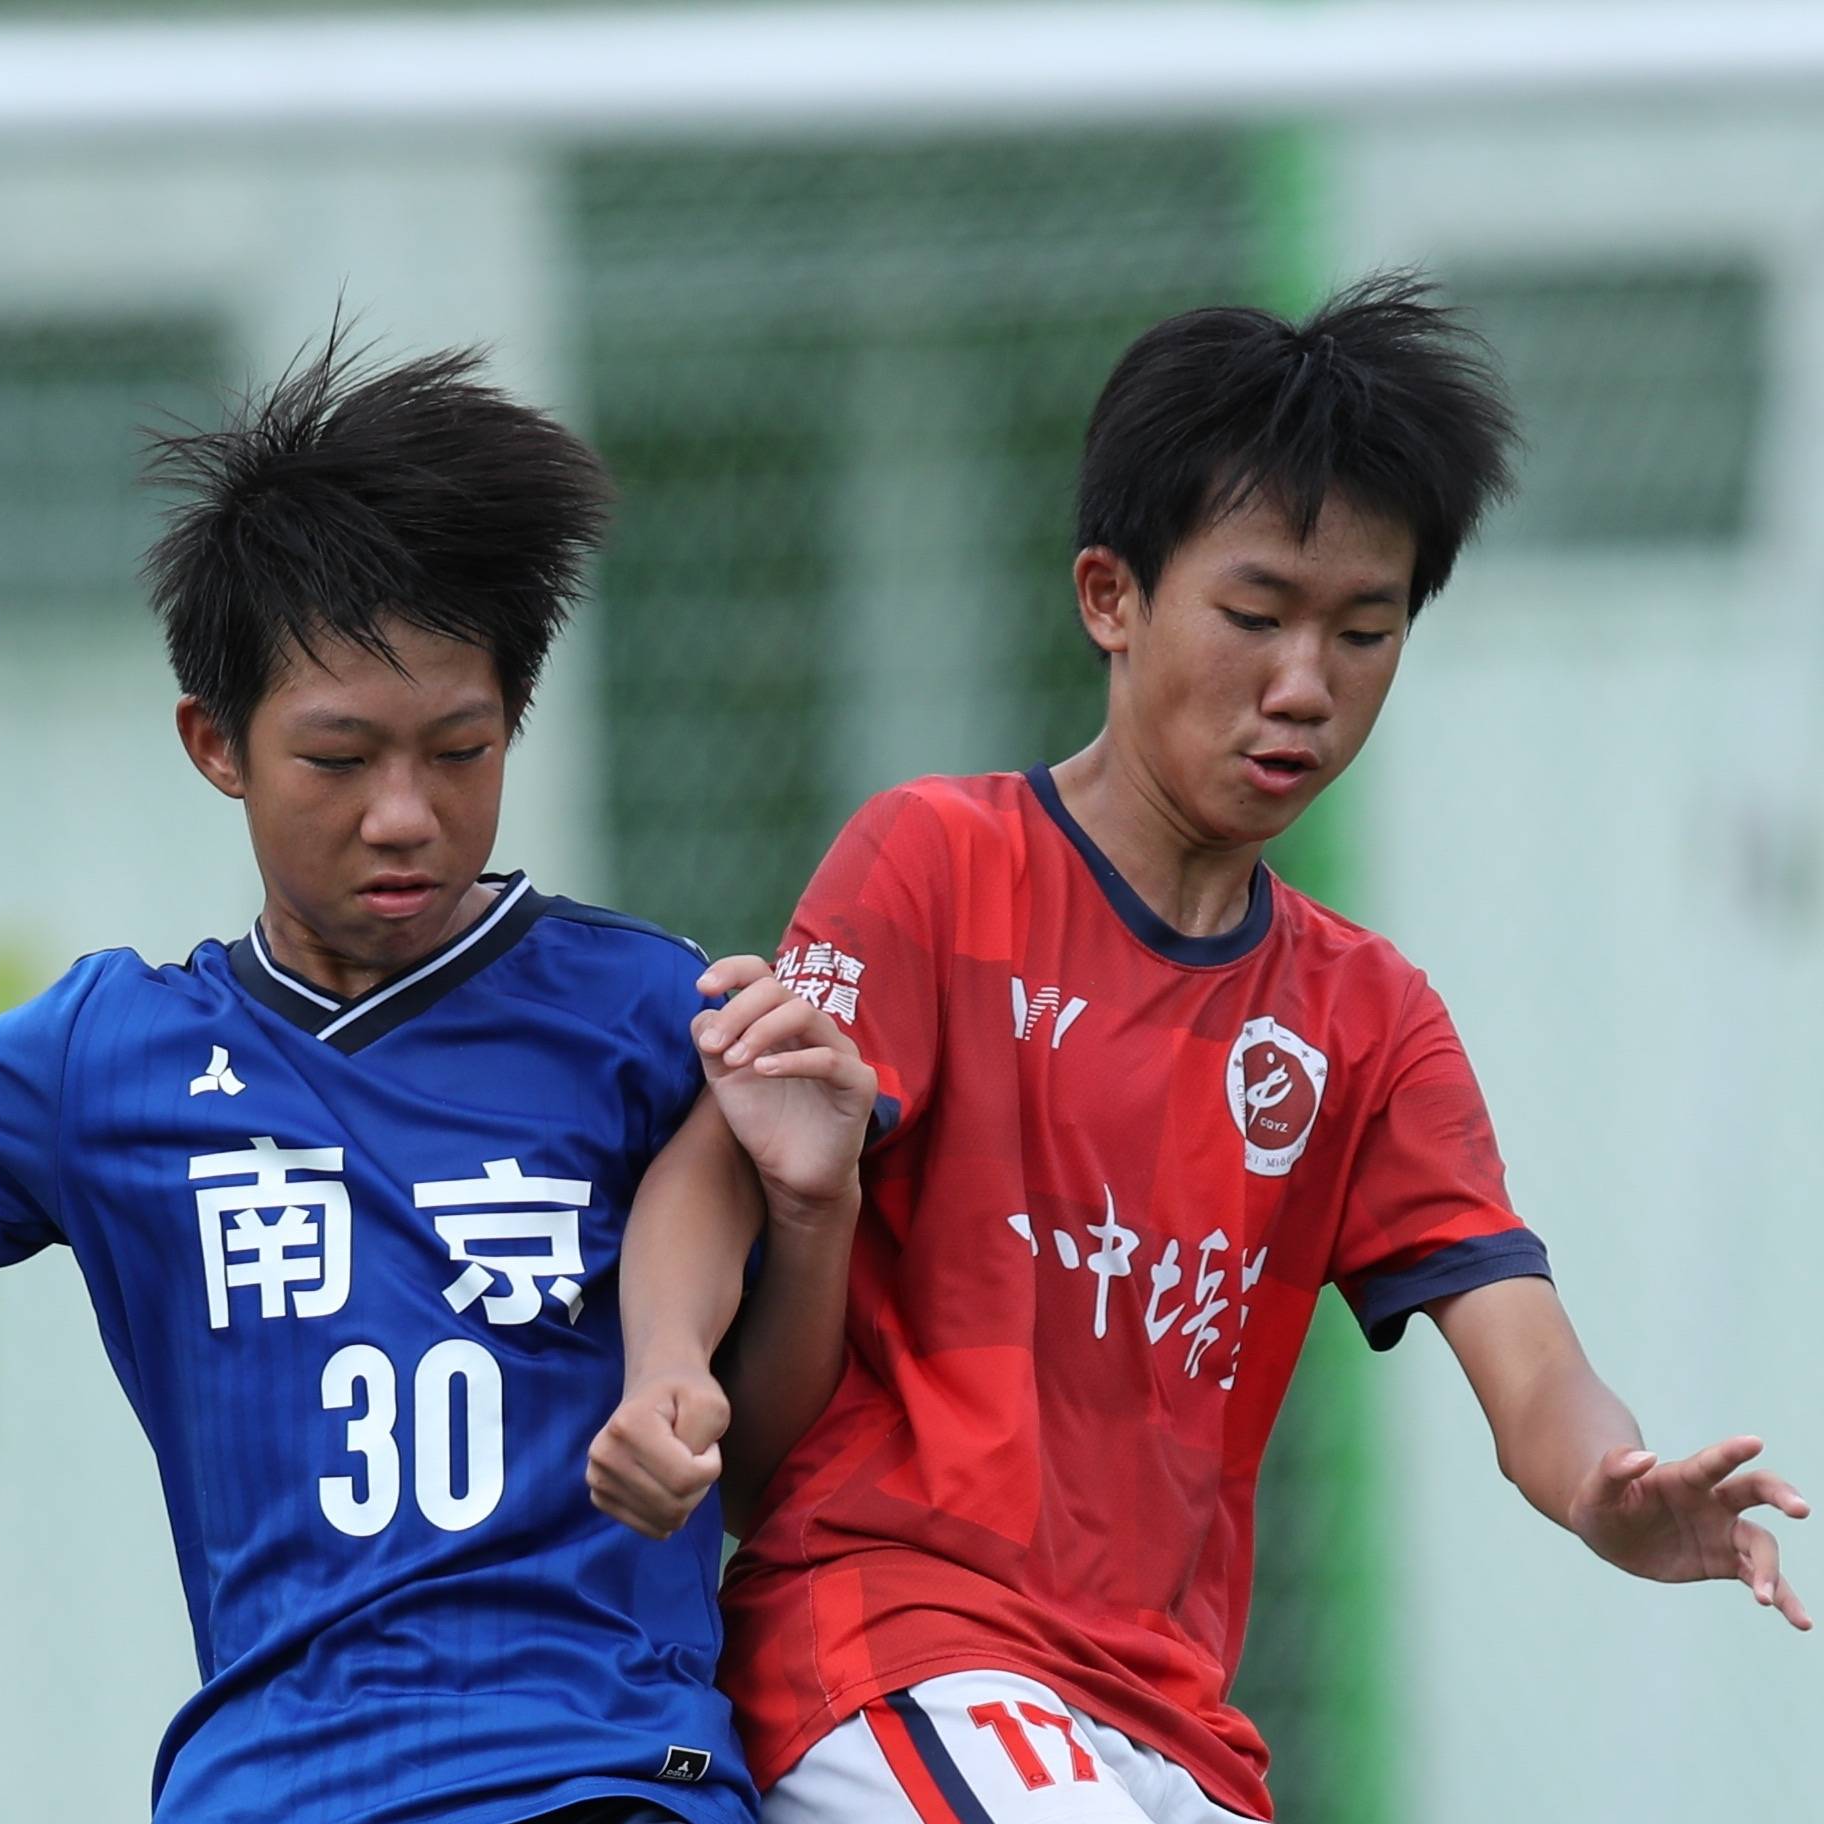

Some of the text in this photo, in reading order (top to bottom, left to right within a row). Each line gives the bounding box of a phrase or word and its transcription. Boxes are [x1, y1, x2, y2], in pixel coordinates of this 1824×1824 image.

[1260, 1116, 1289, 1133] CQYZ
[188, 1136, 593, 1329] 南京
[318, 1339, 505, 1537] 30
[966, 1699, 1100, 1792] 17
